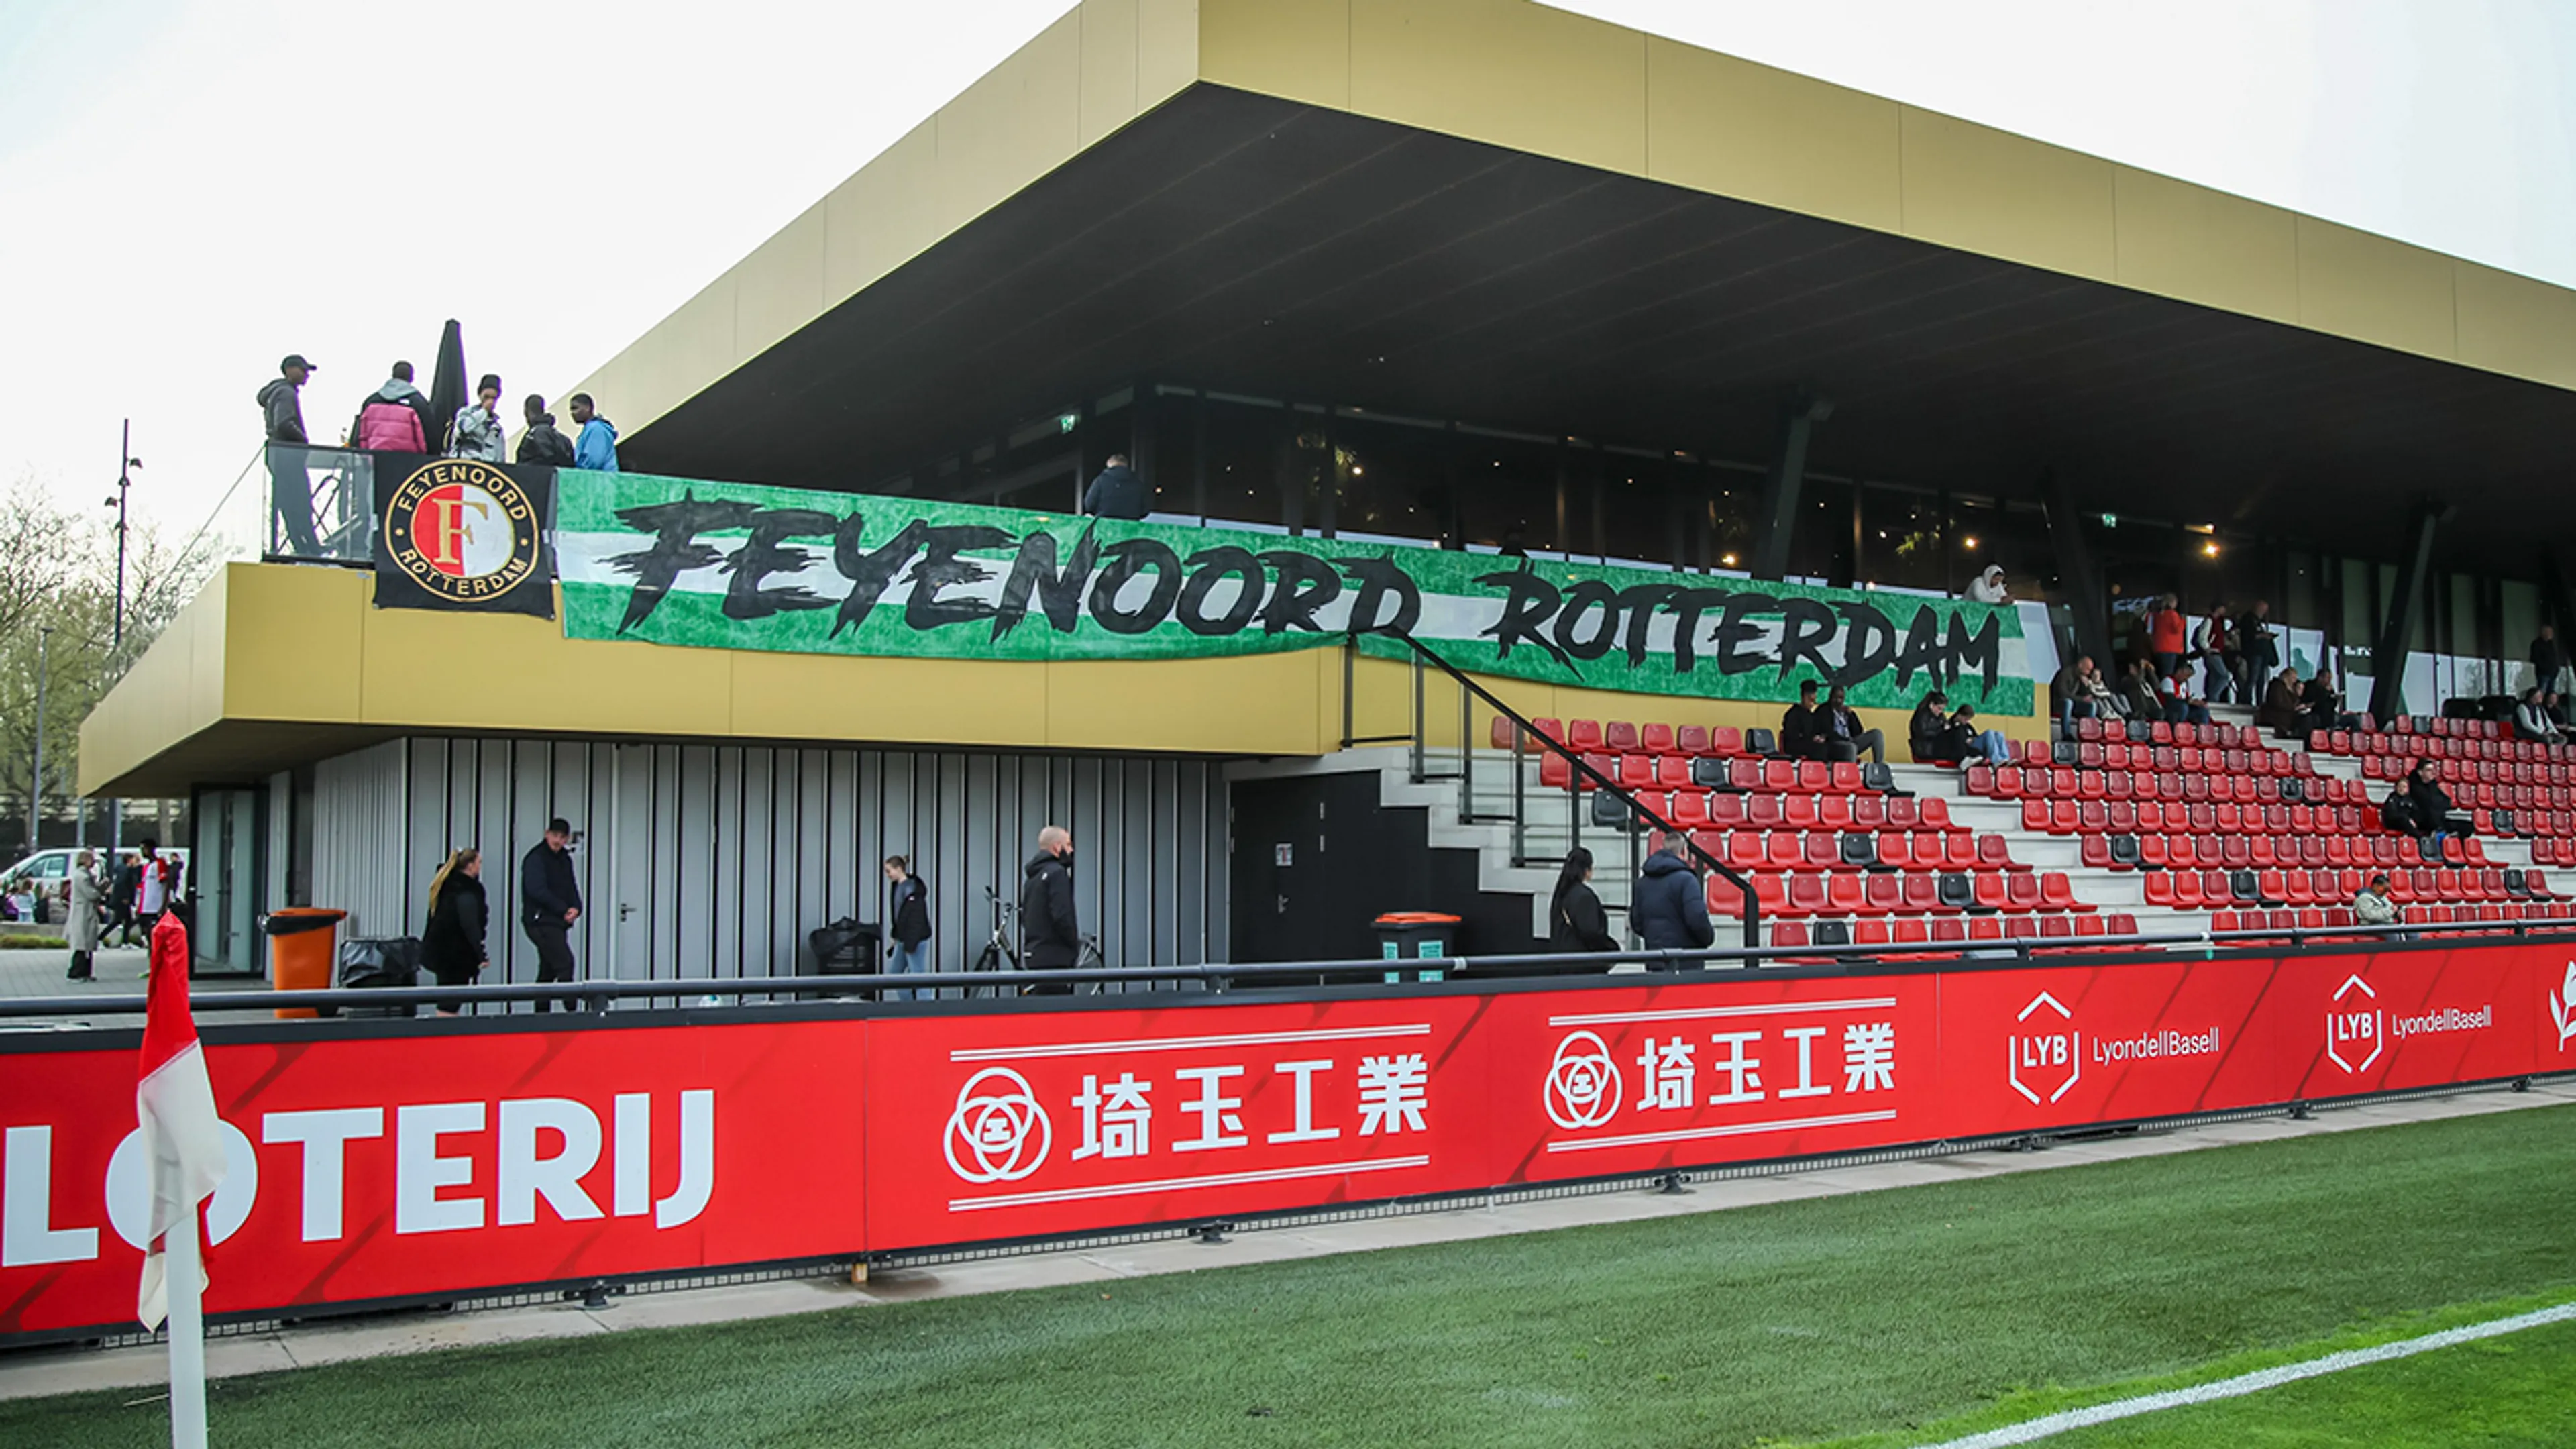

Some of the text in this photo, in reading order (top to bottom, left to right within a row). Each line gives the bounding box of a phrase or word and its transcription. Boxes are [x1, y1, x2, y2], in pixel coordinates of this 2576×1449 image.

[398, 466, 527, 520] FEYENOORD
[432, 498, 488, 564] F
[400, 549, 528, 595] ROTTERDAM
[590, 487, 2000, 704] FEYENOORD ROTTERDAM
[2023, 1026, 2219, 1067] LYB LyondellBasell
[2338, 1005, 2493, 1041] LYB LyondellBasell
[1635, 1021, 1896, 1112] 埼玉工業
[1071, 1053, 1428, 1162] 埼玉工業
